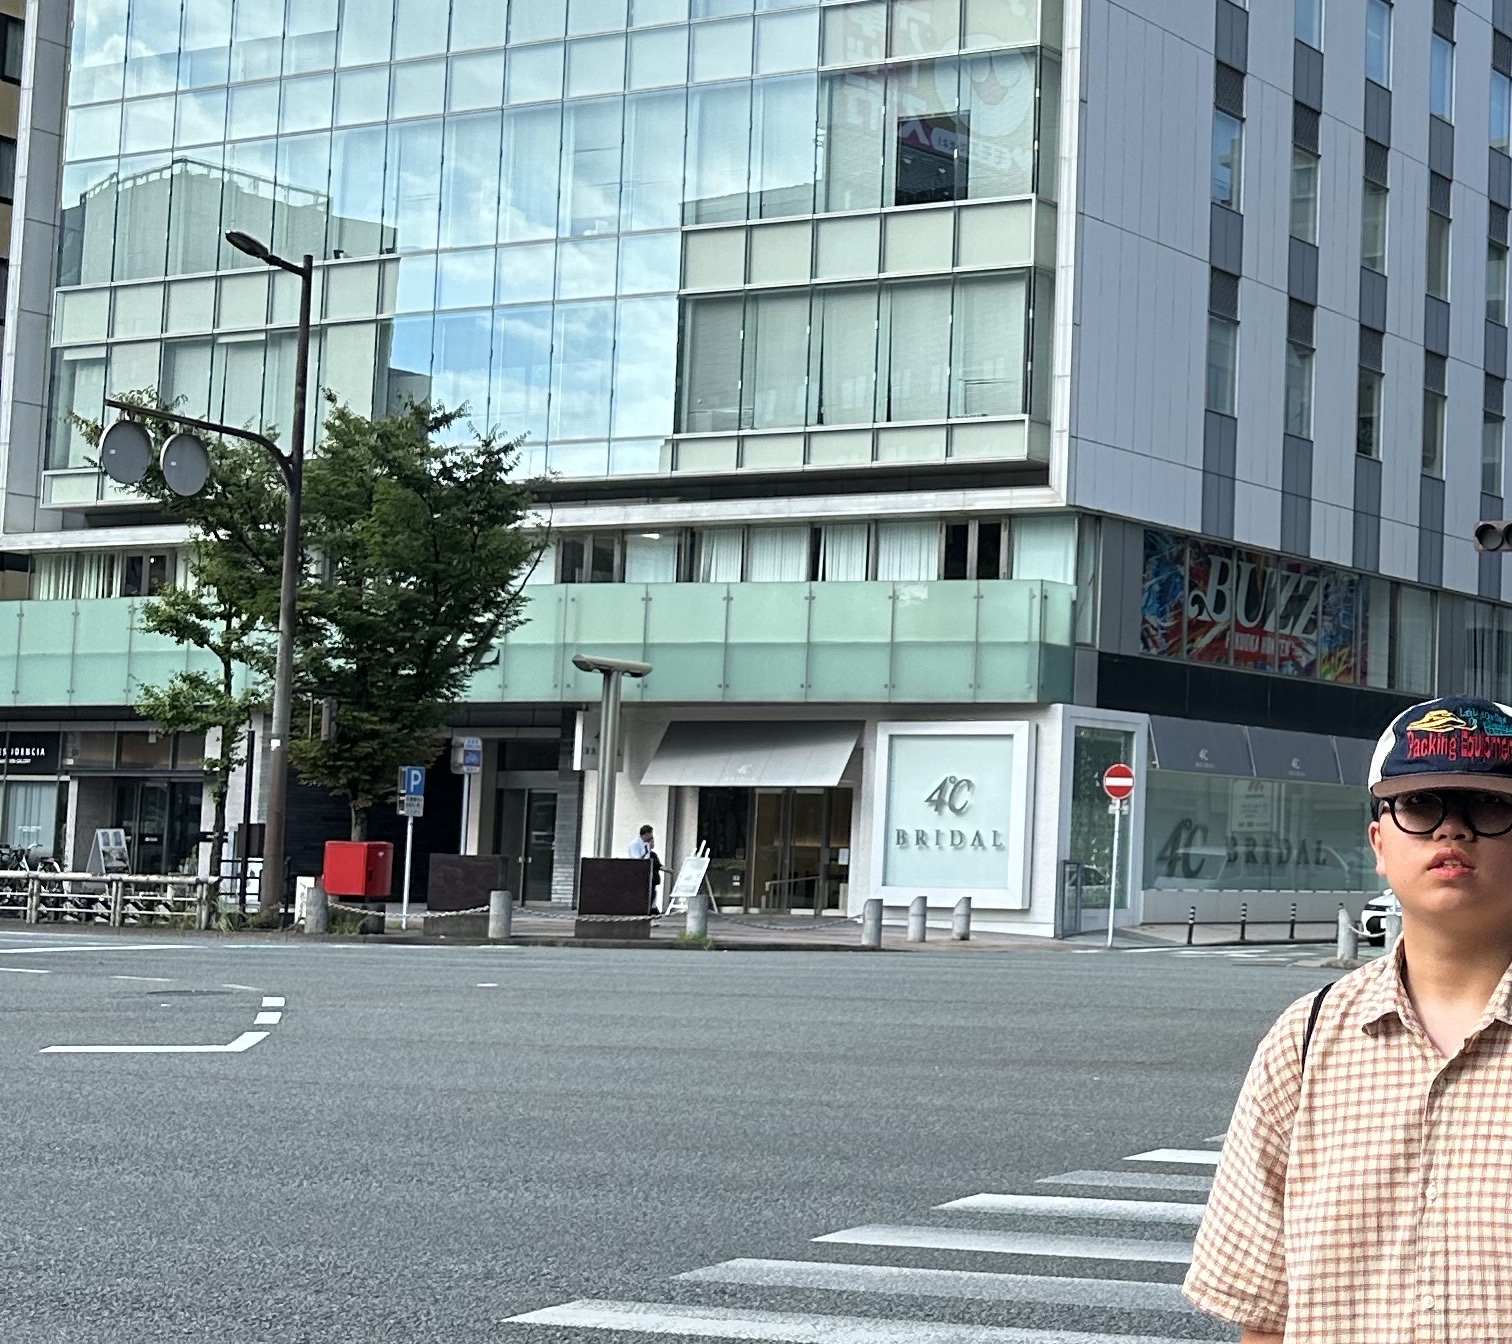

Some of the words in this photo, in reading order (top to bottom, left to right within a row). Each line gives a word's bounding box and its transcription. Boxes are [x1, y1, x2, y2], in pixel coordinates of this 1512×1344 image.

[1188, 555, 1319, 640] BUZZ
[1406, 730, 1458, 761] Packing
[410, 769, 422, 792] P
[896, 828, 1004, 849] BRIDAL
[1226, 835, 1327, 866] BRIDAL
